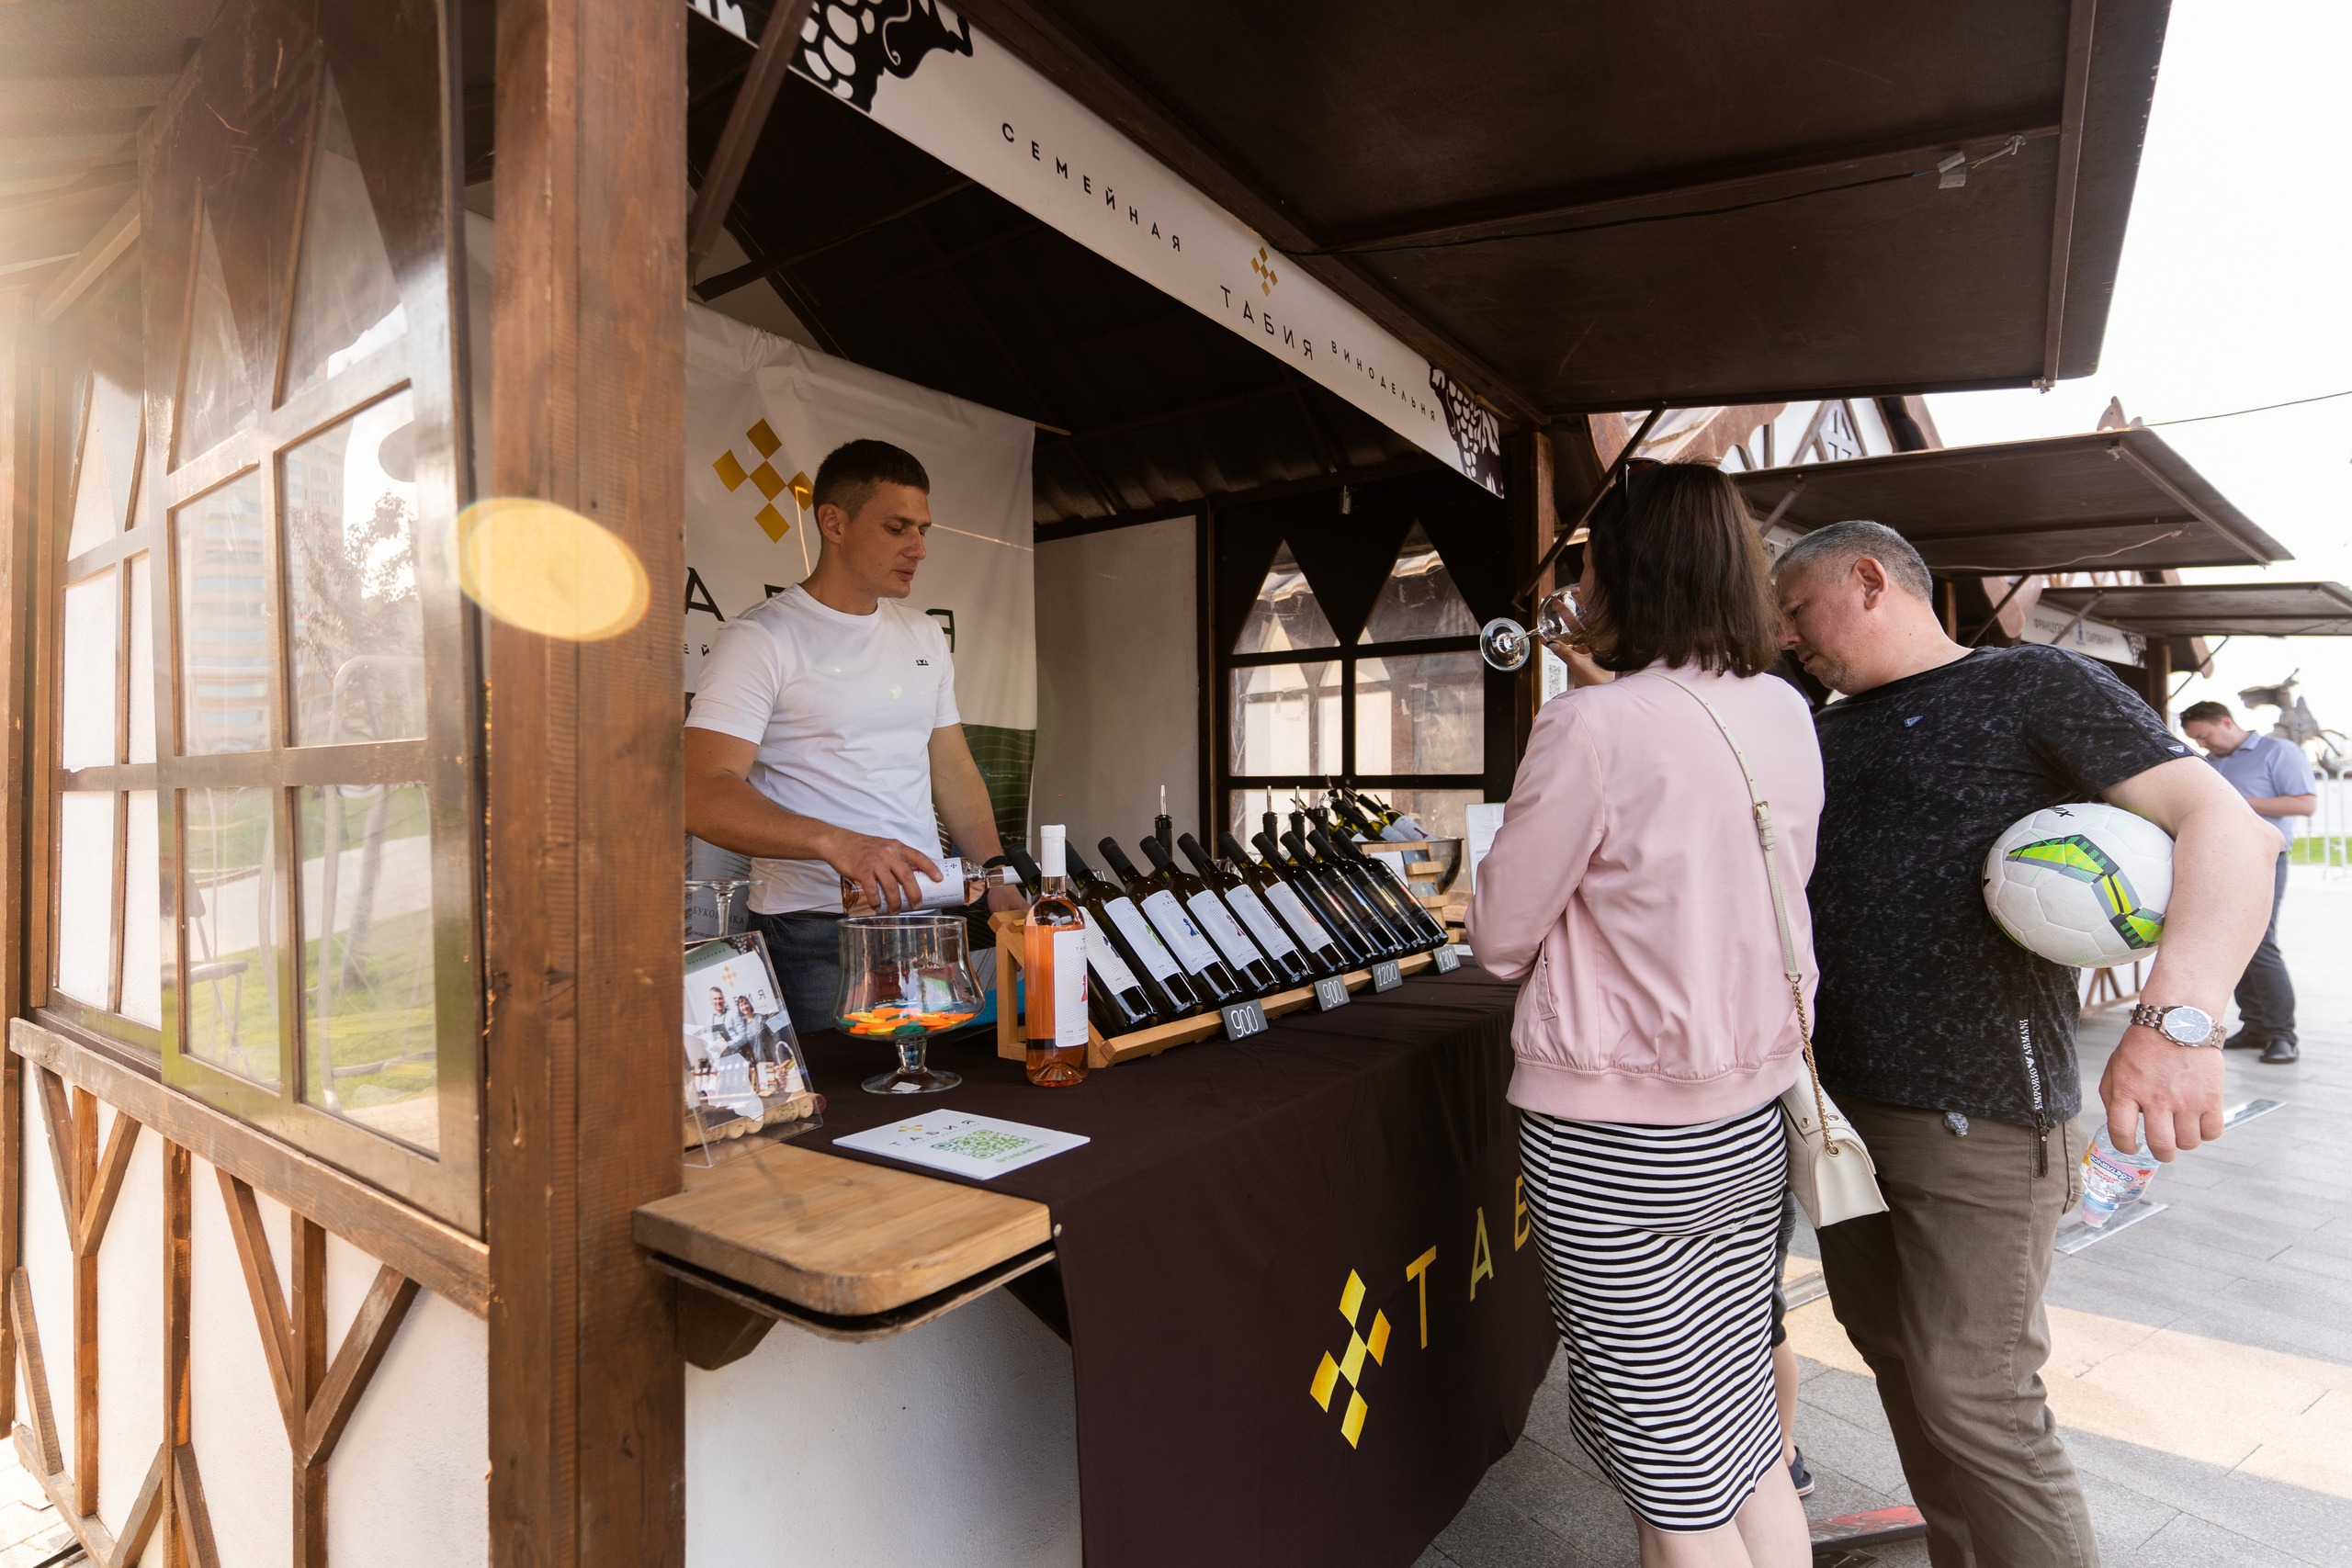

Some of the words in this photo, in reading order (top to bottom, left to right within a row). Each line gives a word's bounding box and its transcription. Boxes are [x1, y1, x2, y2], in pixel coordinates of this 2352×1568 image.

[1002, 123, 1181, 253] СЕМЕЙНАЯ
[1220, 285, 1314, 361] ТАБИЯ
[1330, 340, 1435, 423] ВИНОДЕЛЬНЯ
[1376, 963, 1398, 987] 1200
[1438, 949, 1457, 971] 1300
[1322, 980, 1344, 1008] 900
[1230, 1005, 1260, 1038] 900
[2019, 1019, 2033, 1055] ARMANI
[2029, 1067, 2043, 1110] EMPORIO
